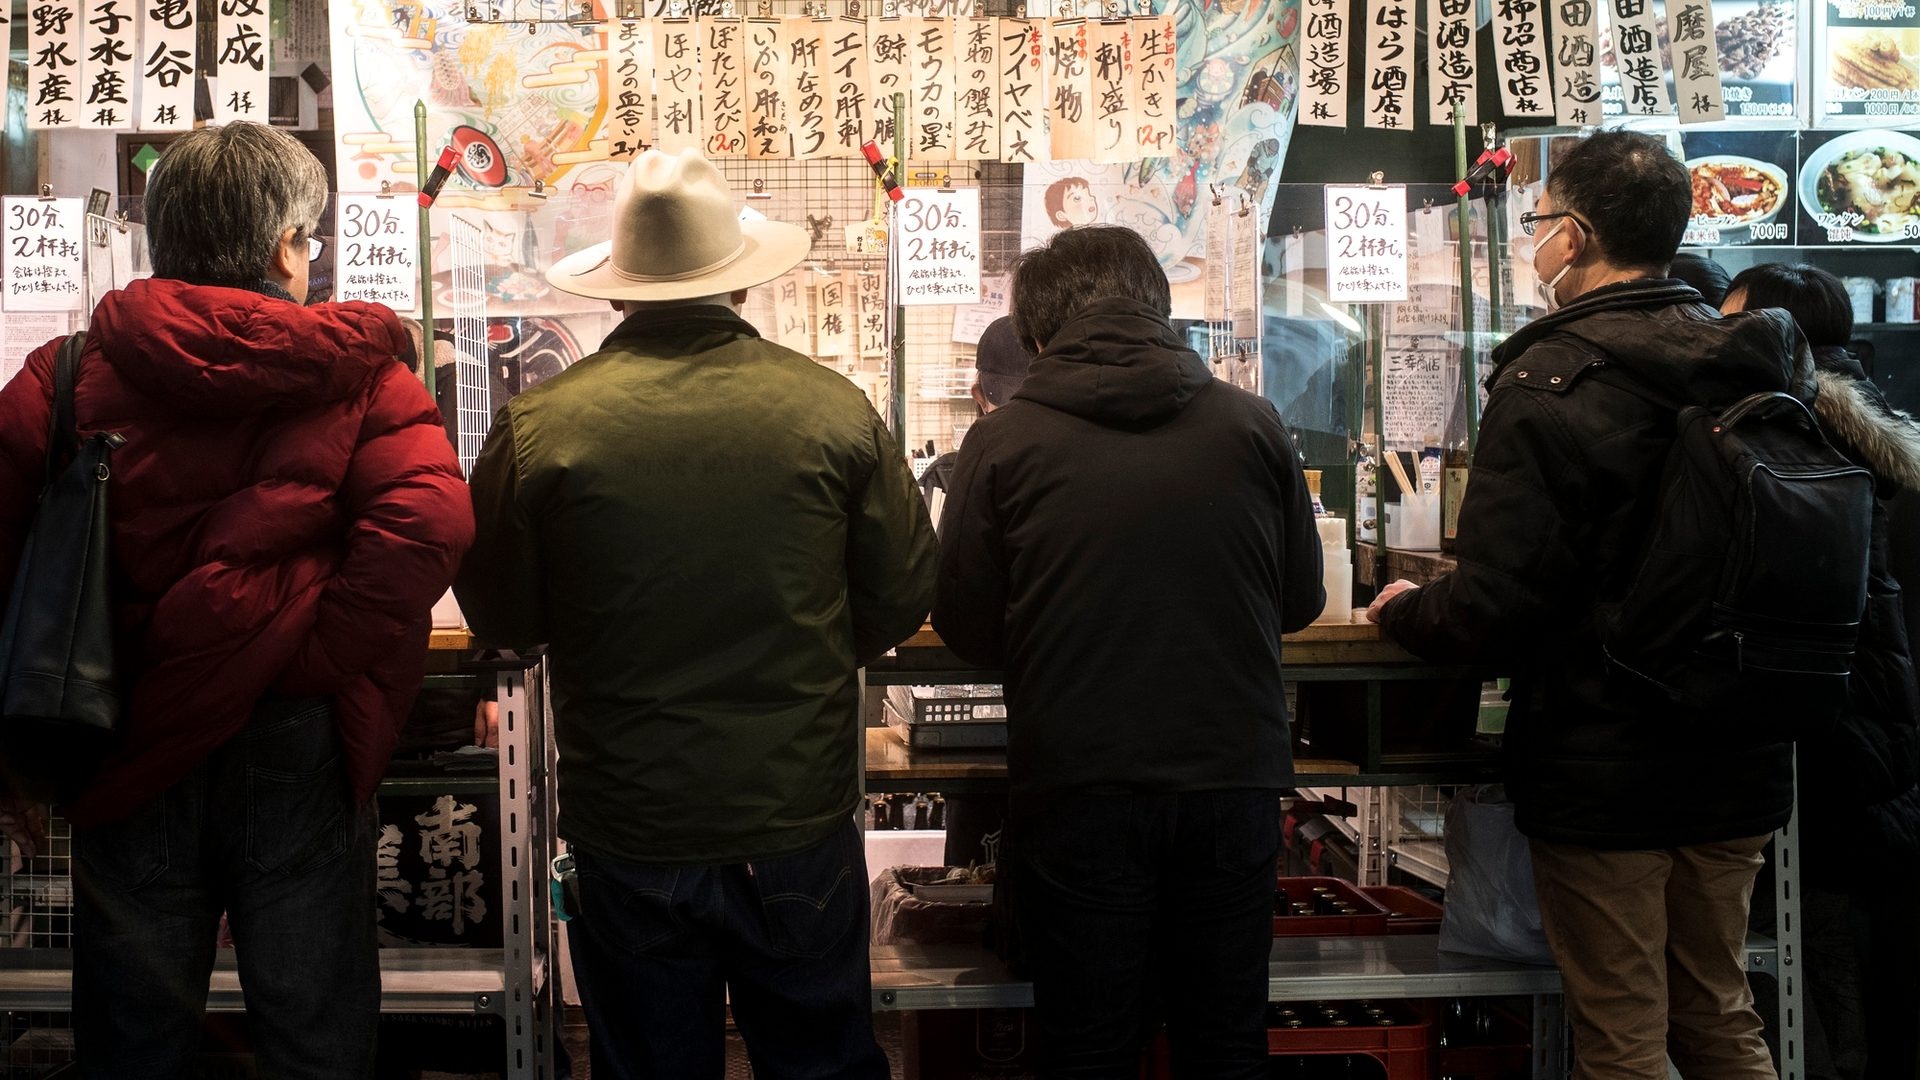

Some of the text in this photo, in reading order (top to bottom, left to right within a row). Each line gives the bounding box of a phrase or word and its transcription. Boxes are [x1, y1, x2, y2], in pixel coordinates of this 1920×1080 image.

[663, 33, 693, 135] ほや刺
[1750, 224, 1788, 239] 700円
[414, 793, 488, 937] 南部
